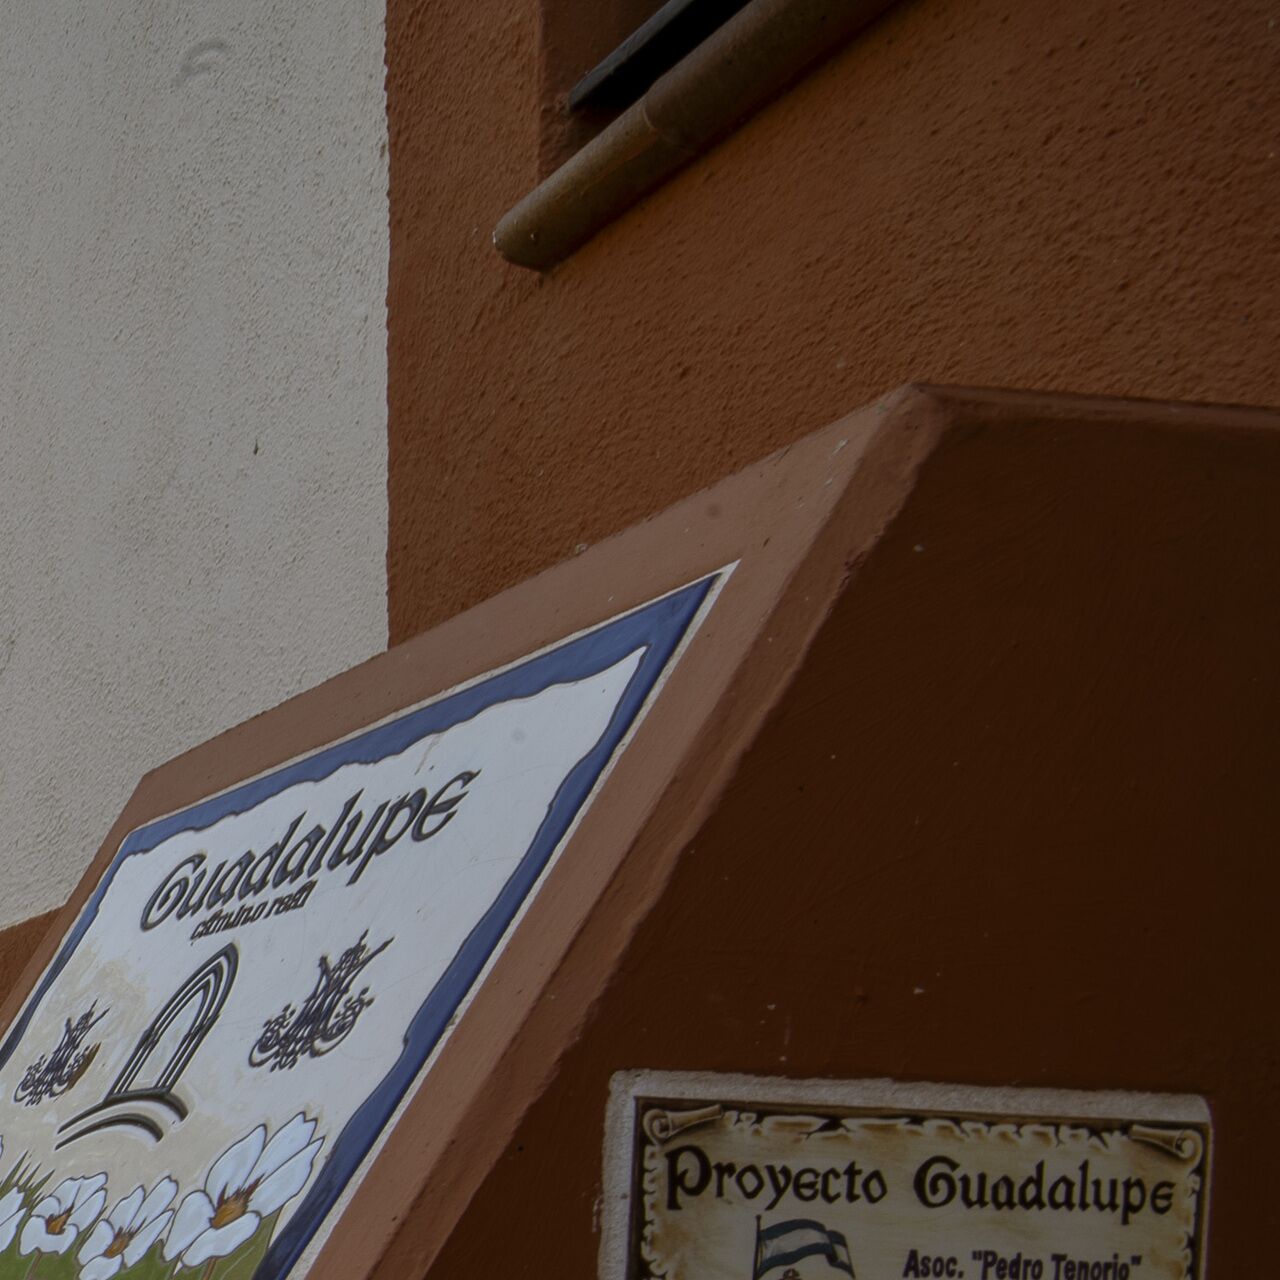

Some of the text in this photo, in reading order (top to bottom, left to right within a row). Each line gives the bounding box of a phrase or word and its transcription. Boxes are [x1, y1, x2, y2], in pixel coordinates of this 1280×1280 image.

[141, 769, 482, 932] Guadalupe
[190, 880, 319, 944] camino real
[664, 1144, 1178, 1225] Proyecto Guadalupe
[902, 1249, 964, 1280] Asoc.
